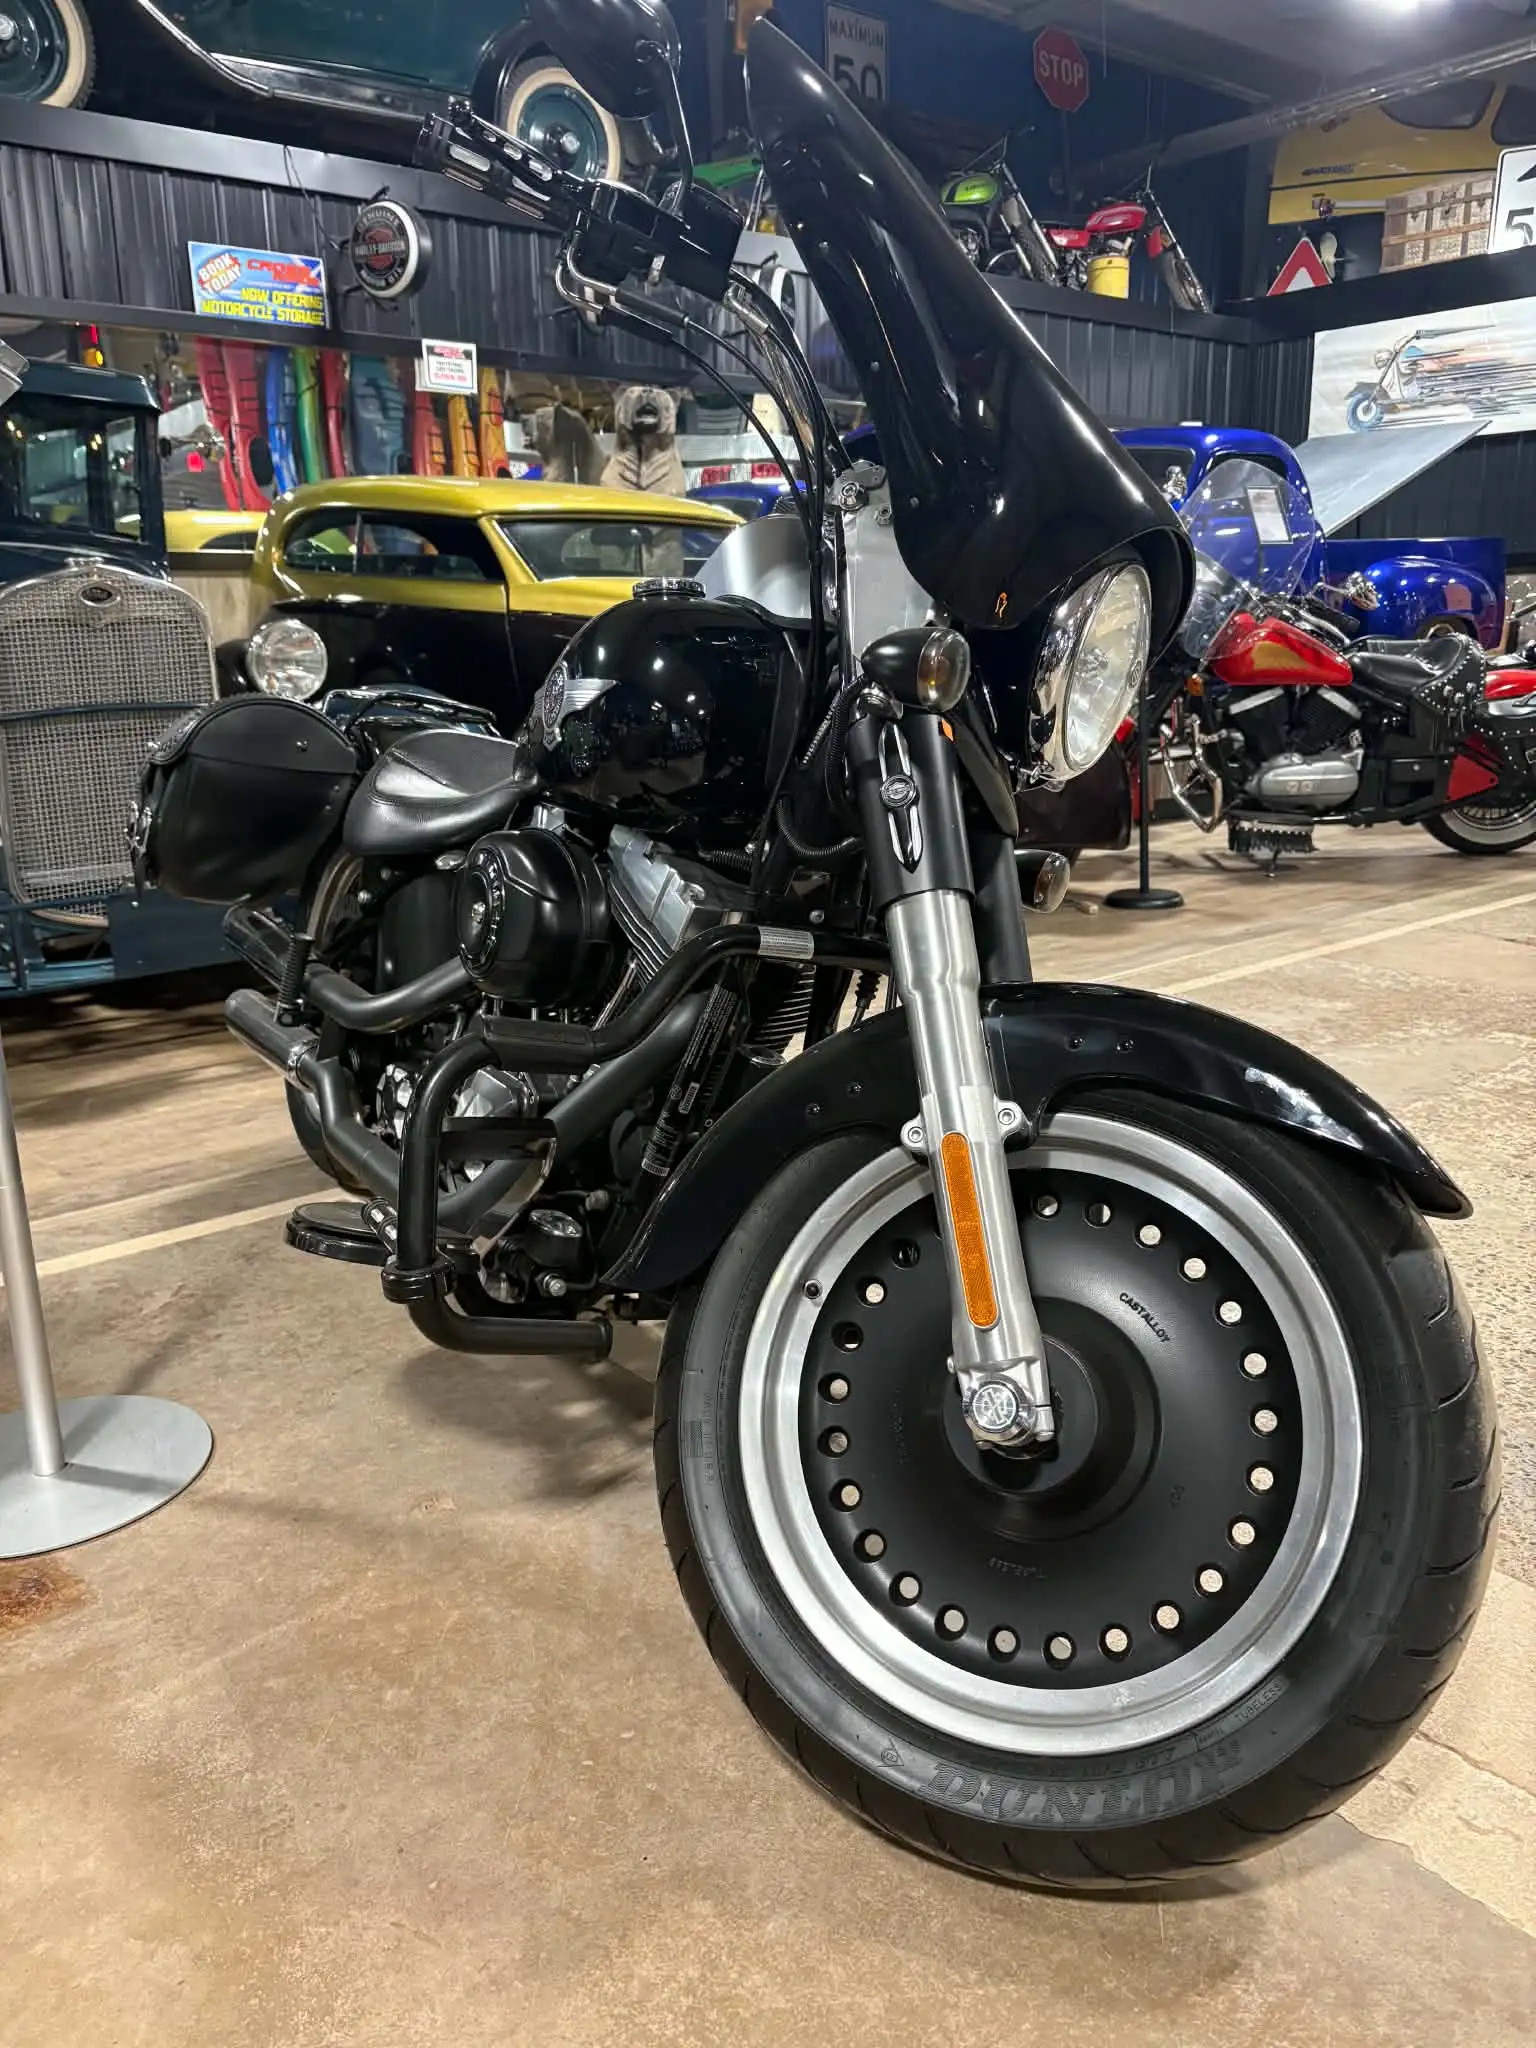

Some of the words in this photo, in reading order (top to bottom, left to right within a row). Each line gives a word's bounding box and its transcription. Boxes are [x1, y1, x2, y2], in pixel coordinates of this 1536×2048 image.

[829, 19, 884, 49] MAXIMUM
[833, 54, 883, 101] 50
[1040, 50, 1083, 88] STOP
[357, 210, 401, 233] GENUINE
[354, 239, 406, 256] HARLEY-DAVIDSON
[198, 252, 235, 280] BOOK
[202, 263, 242, 293] TODAY
[201, 299, 274, 320] MOTORCYCLE
[276, 307, 325, 326] STORAGE
[241, 287, 271, 304] NOW
[271, 290, 324, 310] OFFERING
[1119, 1291, 1171, 1343] CASTALLOY
[917, 1737, 1243, 1826] DUNLOP
